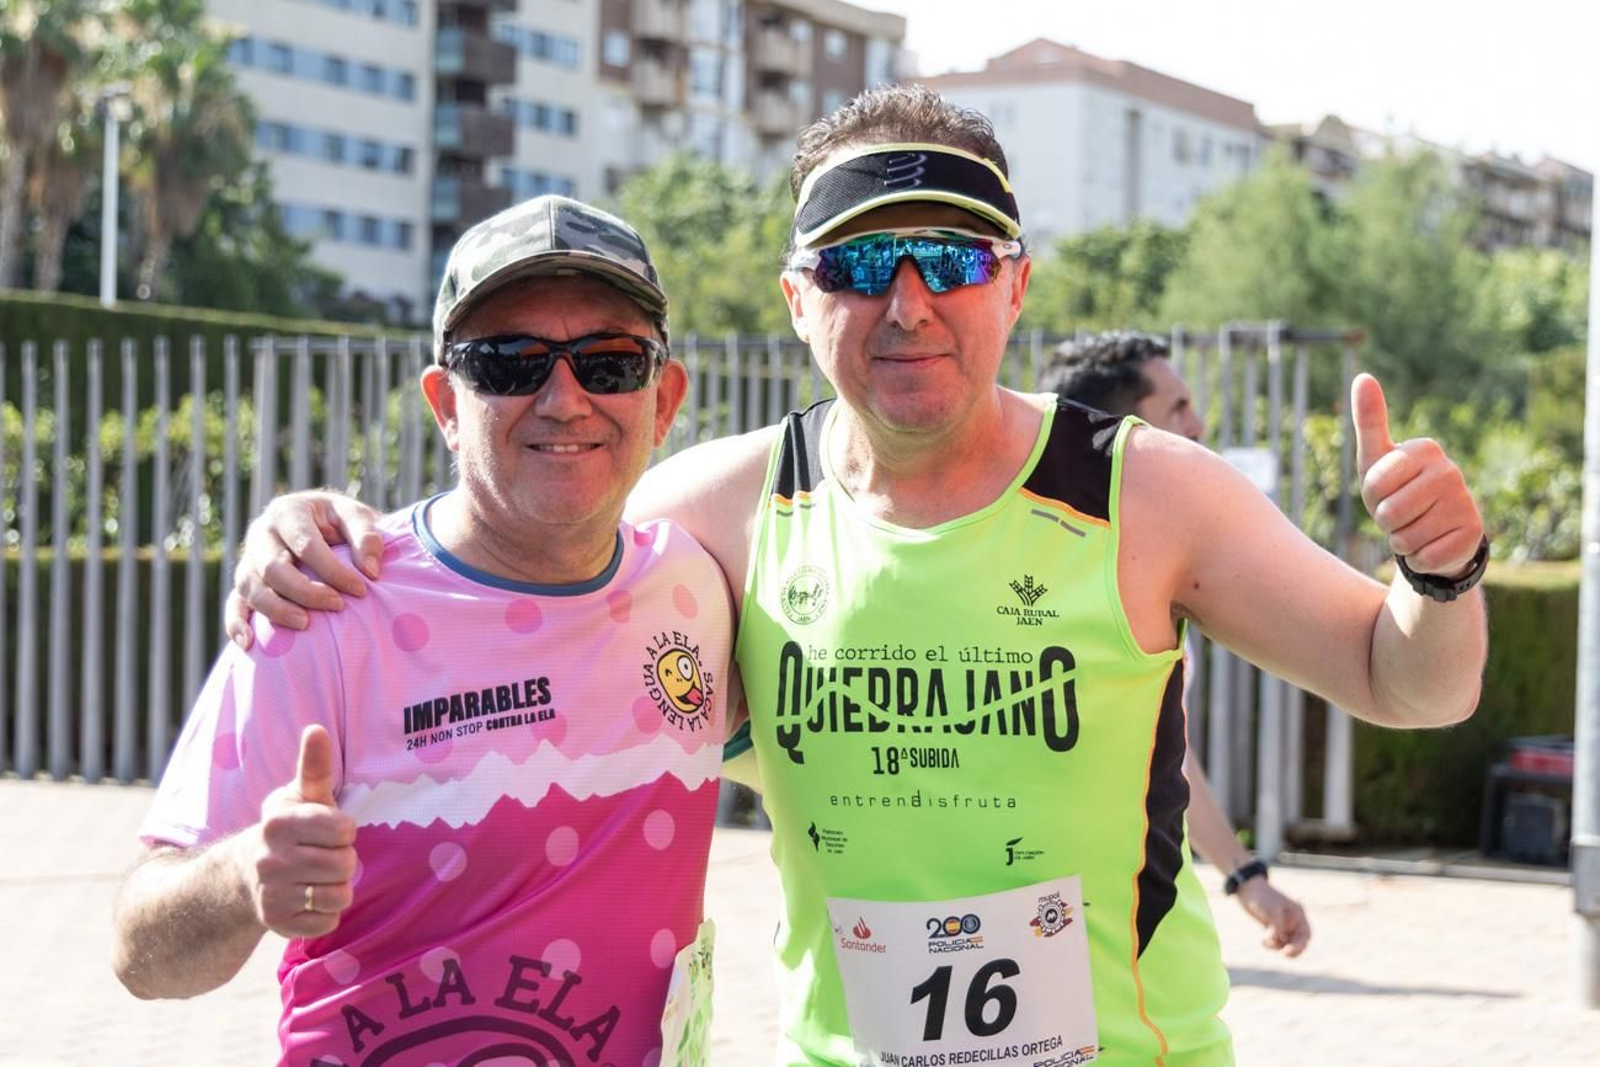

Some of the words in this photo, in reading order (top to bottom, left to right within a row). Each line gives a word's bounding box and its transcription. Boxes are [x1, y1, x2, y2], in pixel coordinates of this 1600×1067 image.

[996, 606, 1021, 616] CAJA
[1023, 608, 1060, 618] RURAL
[646, 646, 658, 660] A
[653, 631, 671, 649] LA
[808, 645, 828, 661] he
[834, 644, 917, 662] corrido
[925, 645, 949, 662] el
[958, 646, 1034, 665] último
[403, 676, 552, 735] IMPARABLES
[643, 663, 685, 730] LENGUA
[700, 671, 714, 720] SACA
[776, 640, 1080, 765] QUIEBRAJANO
[406, 736, 427, 751] 24H
[430, 729, 453, 745] NON
[456, 721, 483, 737] STOP
[486, 714, 522, 731] CONTRA
[525, 711, 536, 724] LA
[538, 708, 556, 722] ELA
[686, 715, 703, 732] LA
[910, 747, 960, 769] SUBIDA
[926, 913, 981, 939] 200
[841, 937, 887, 953] Santander
[928, 944, 984, 954] NACIONAL
[341, 1004, 385, 1054] A
[385, 958, 477, 1019] LA
[494, 954, 621, 1063] ELA
[910, 957, 1020, 1041] 16
[901, 1053, 946, 1067] CARLOS
[949, 1045, 1019, 1065] REDECILLAS
[1021, 1035, 1063, 1056] ORTEGA
